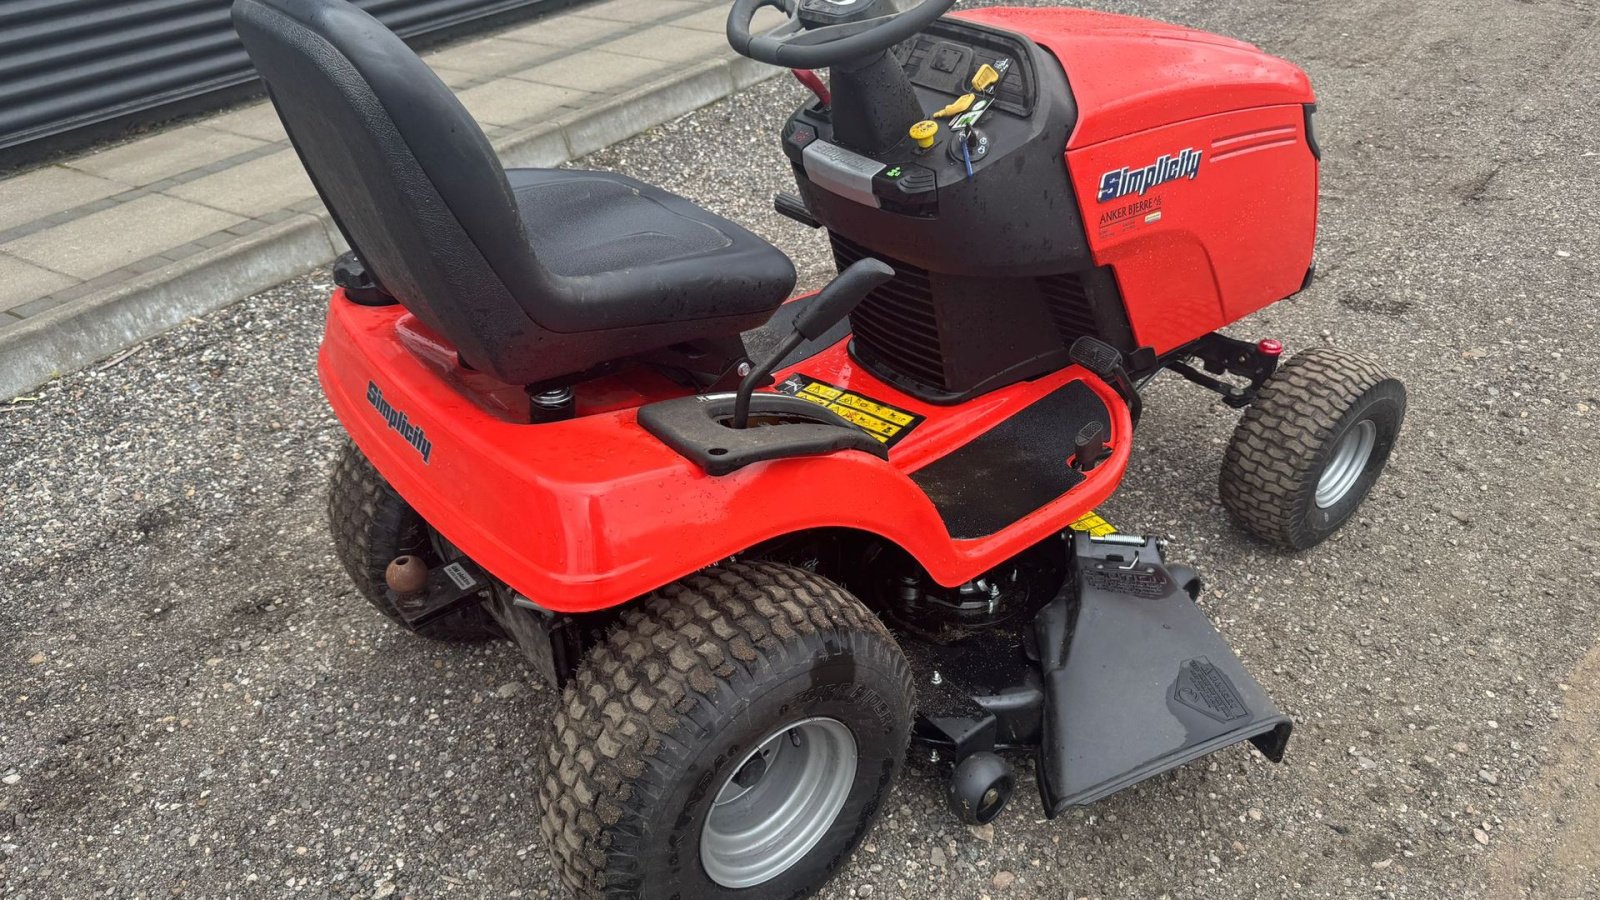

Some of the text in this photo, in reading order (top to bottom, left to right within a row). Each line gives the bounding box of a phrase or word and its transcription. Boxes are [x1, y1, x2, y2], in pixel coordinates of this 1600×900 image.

[1097, 147, 1202, 203] Simplicity
[1099, 208, 1127, 225] ANKER
[1128, 200, 1153, 216] BJERRE
[366, 380, 432, 465] Simplicity
